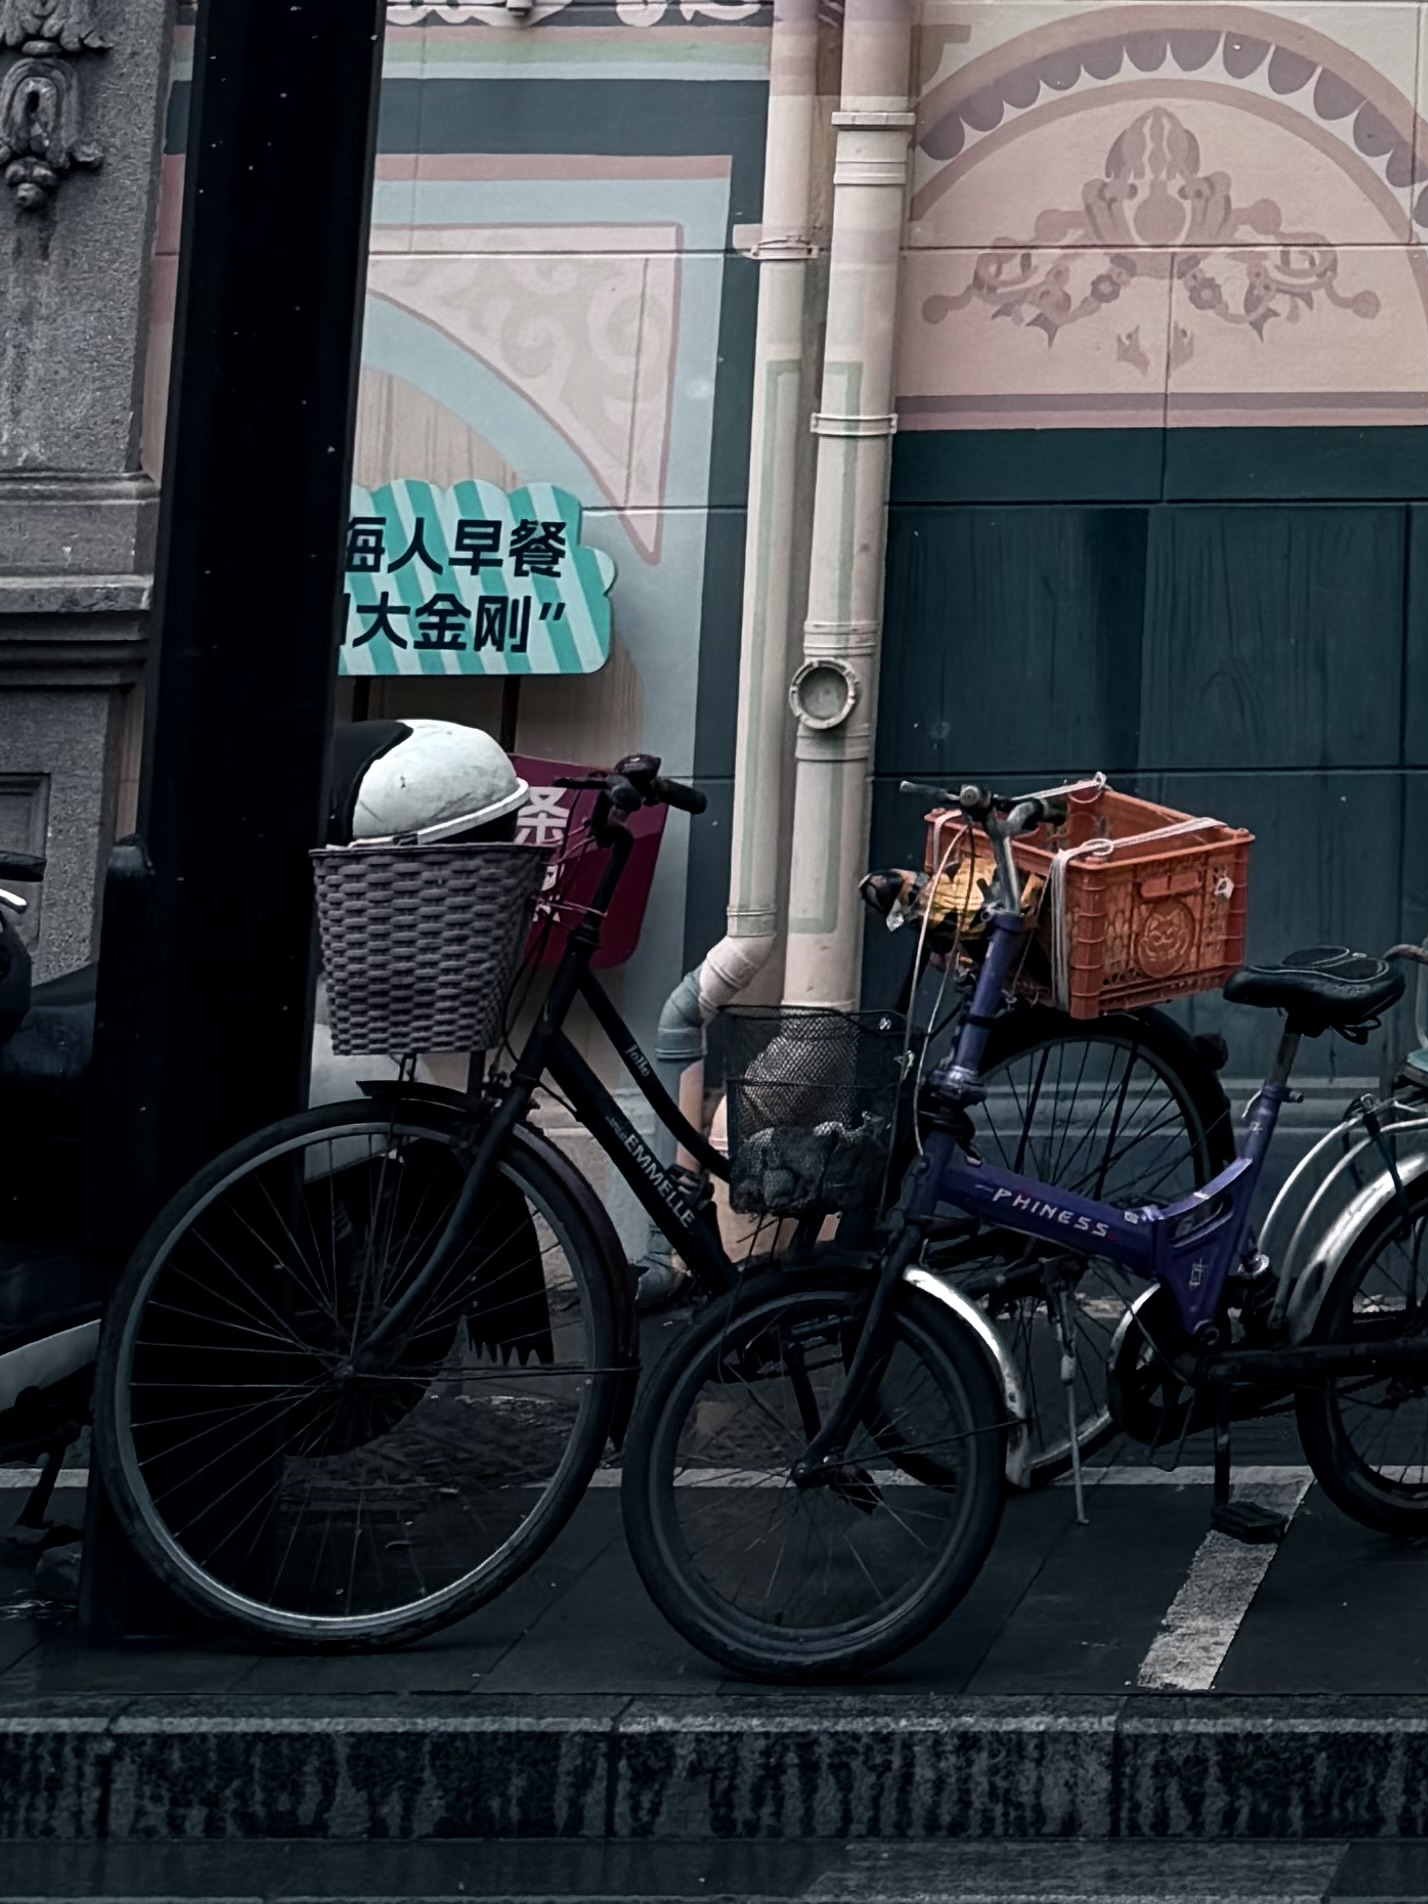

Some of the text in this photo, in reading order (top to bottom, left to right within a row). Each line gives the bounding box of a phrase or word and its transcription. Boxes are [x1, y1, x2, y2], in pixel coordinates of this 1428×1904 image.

[339, 592, 567, 653] 大金刚”
[621, 1133, 697, 1229] EMMELLE
[991, 1186, 1111, 1239] PHINESS
